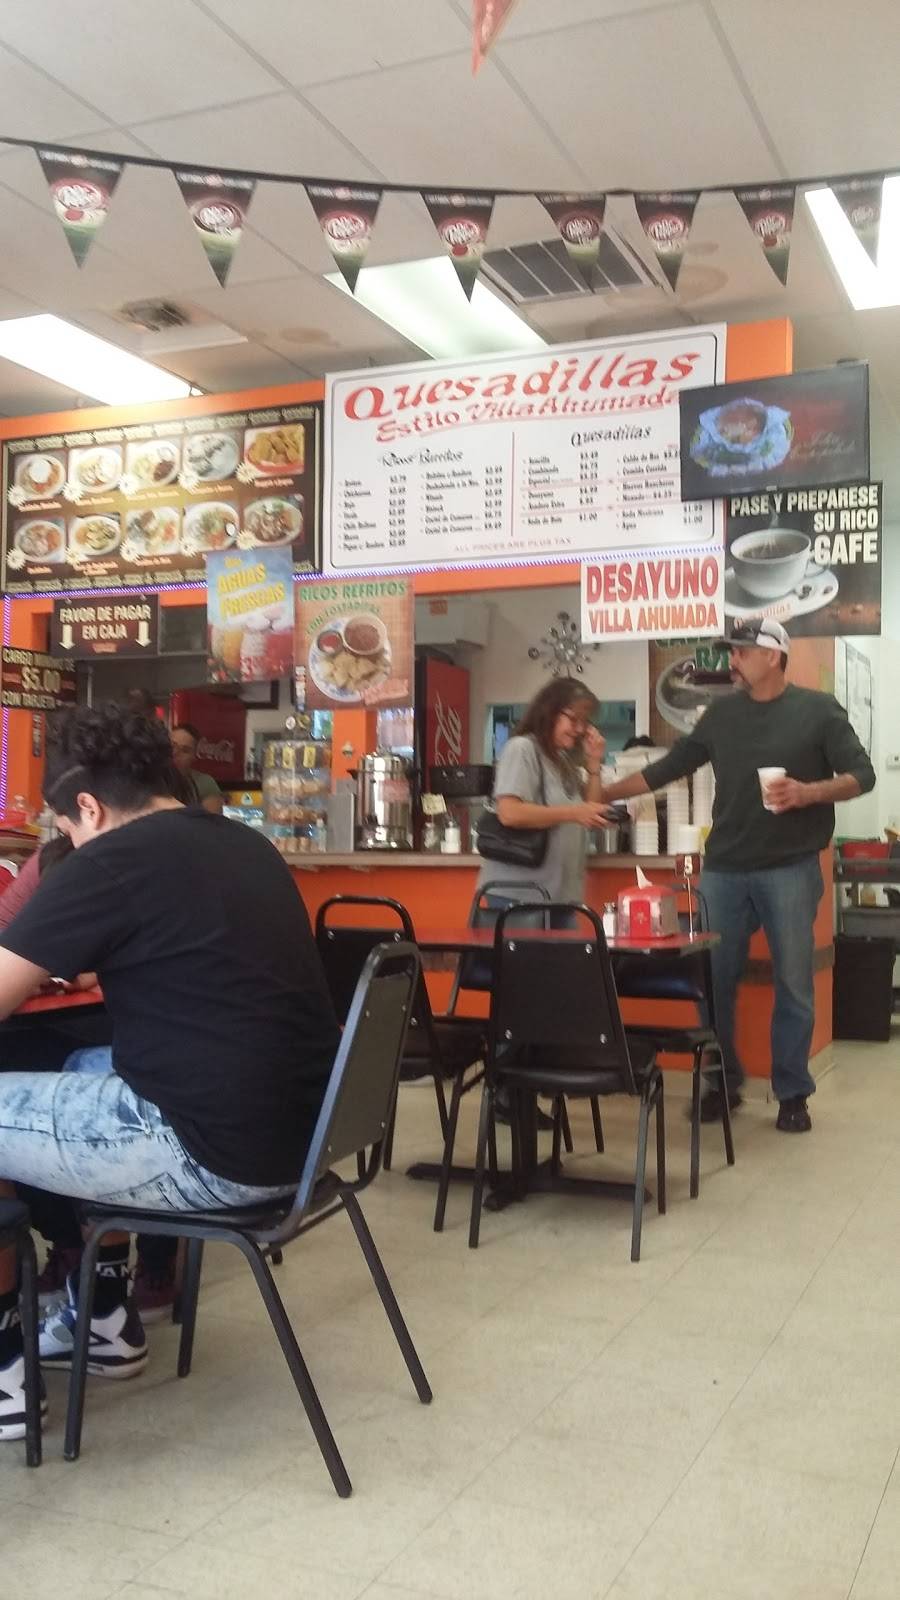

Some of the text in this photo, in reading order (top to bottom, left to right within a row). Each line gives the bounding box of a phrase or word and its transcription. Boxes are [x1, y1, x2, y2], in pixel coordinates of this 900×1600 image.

[344, 352, 701, 421] Quesadillas
[376, 411, 460, 442] Estilo
[570, 424, 652, 447] Quesadillas
[731, 485, 878, 517] PASE Y PREPARESE
[813, 508, 878, 533] SU RICO
[814, 532, 878, 565] CAFE
[301, 581, 406, 601] RICOS REFRITOS
[586, 556, 719, 604] DESAYUNO
[60, 604, 151, 623] FAVOR DE PASAR
[588, 602, 718, 634] VILLA AHUMADA
[82, 623, 128, 640] EN CAJA
